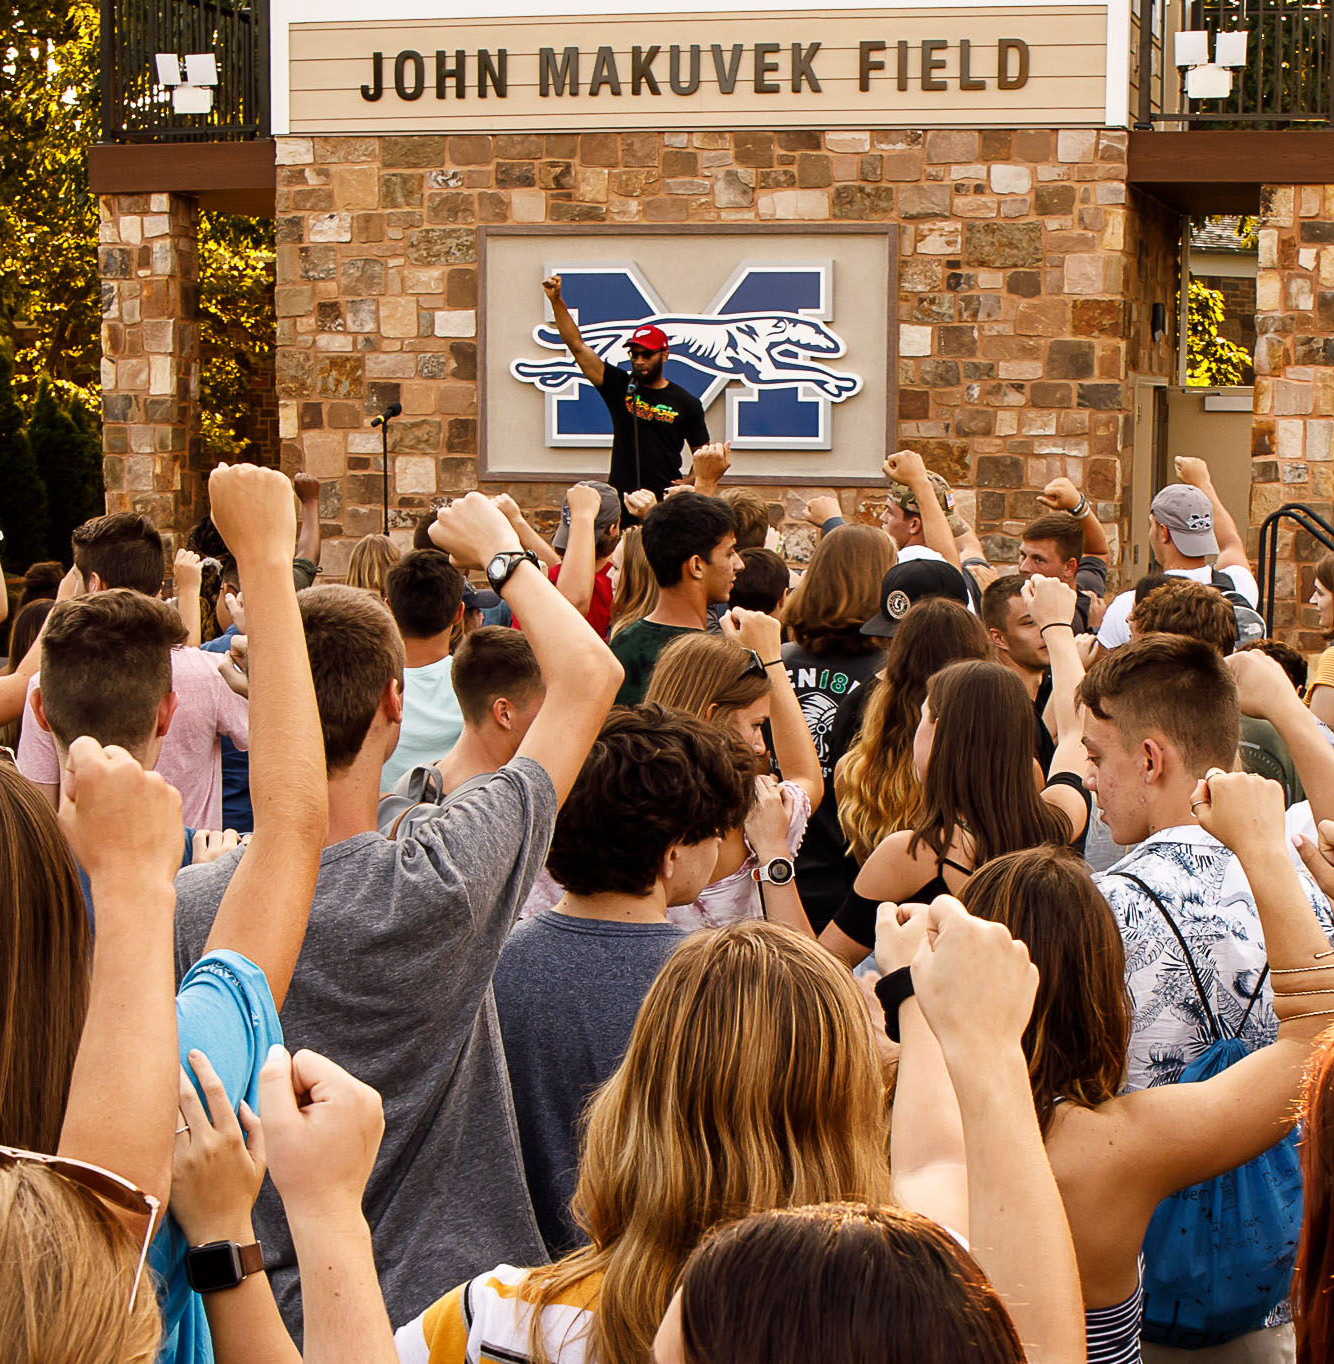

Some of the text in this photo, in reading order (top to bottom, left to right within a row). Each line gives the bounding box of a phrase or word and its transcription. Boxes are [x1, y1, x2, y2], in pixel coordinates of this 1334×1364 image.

[360, 38, 1030, 102] JOHN MAKUVEK FIELD
